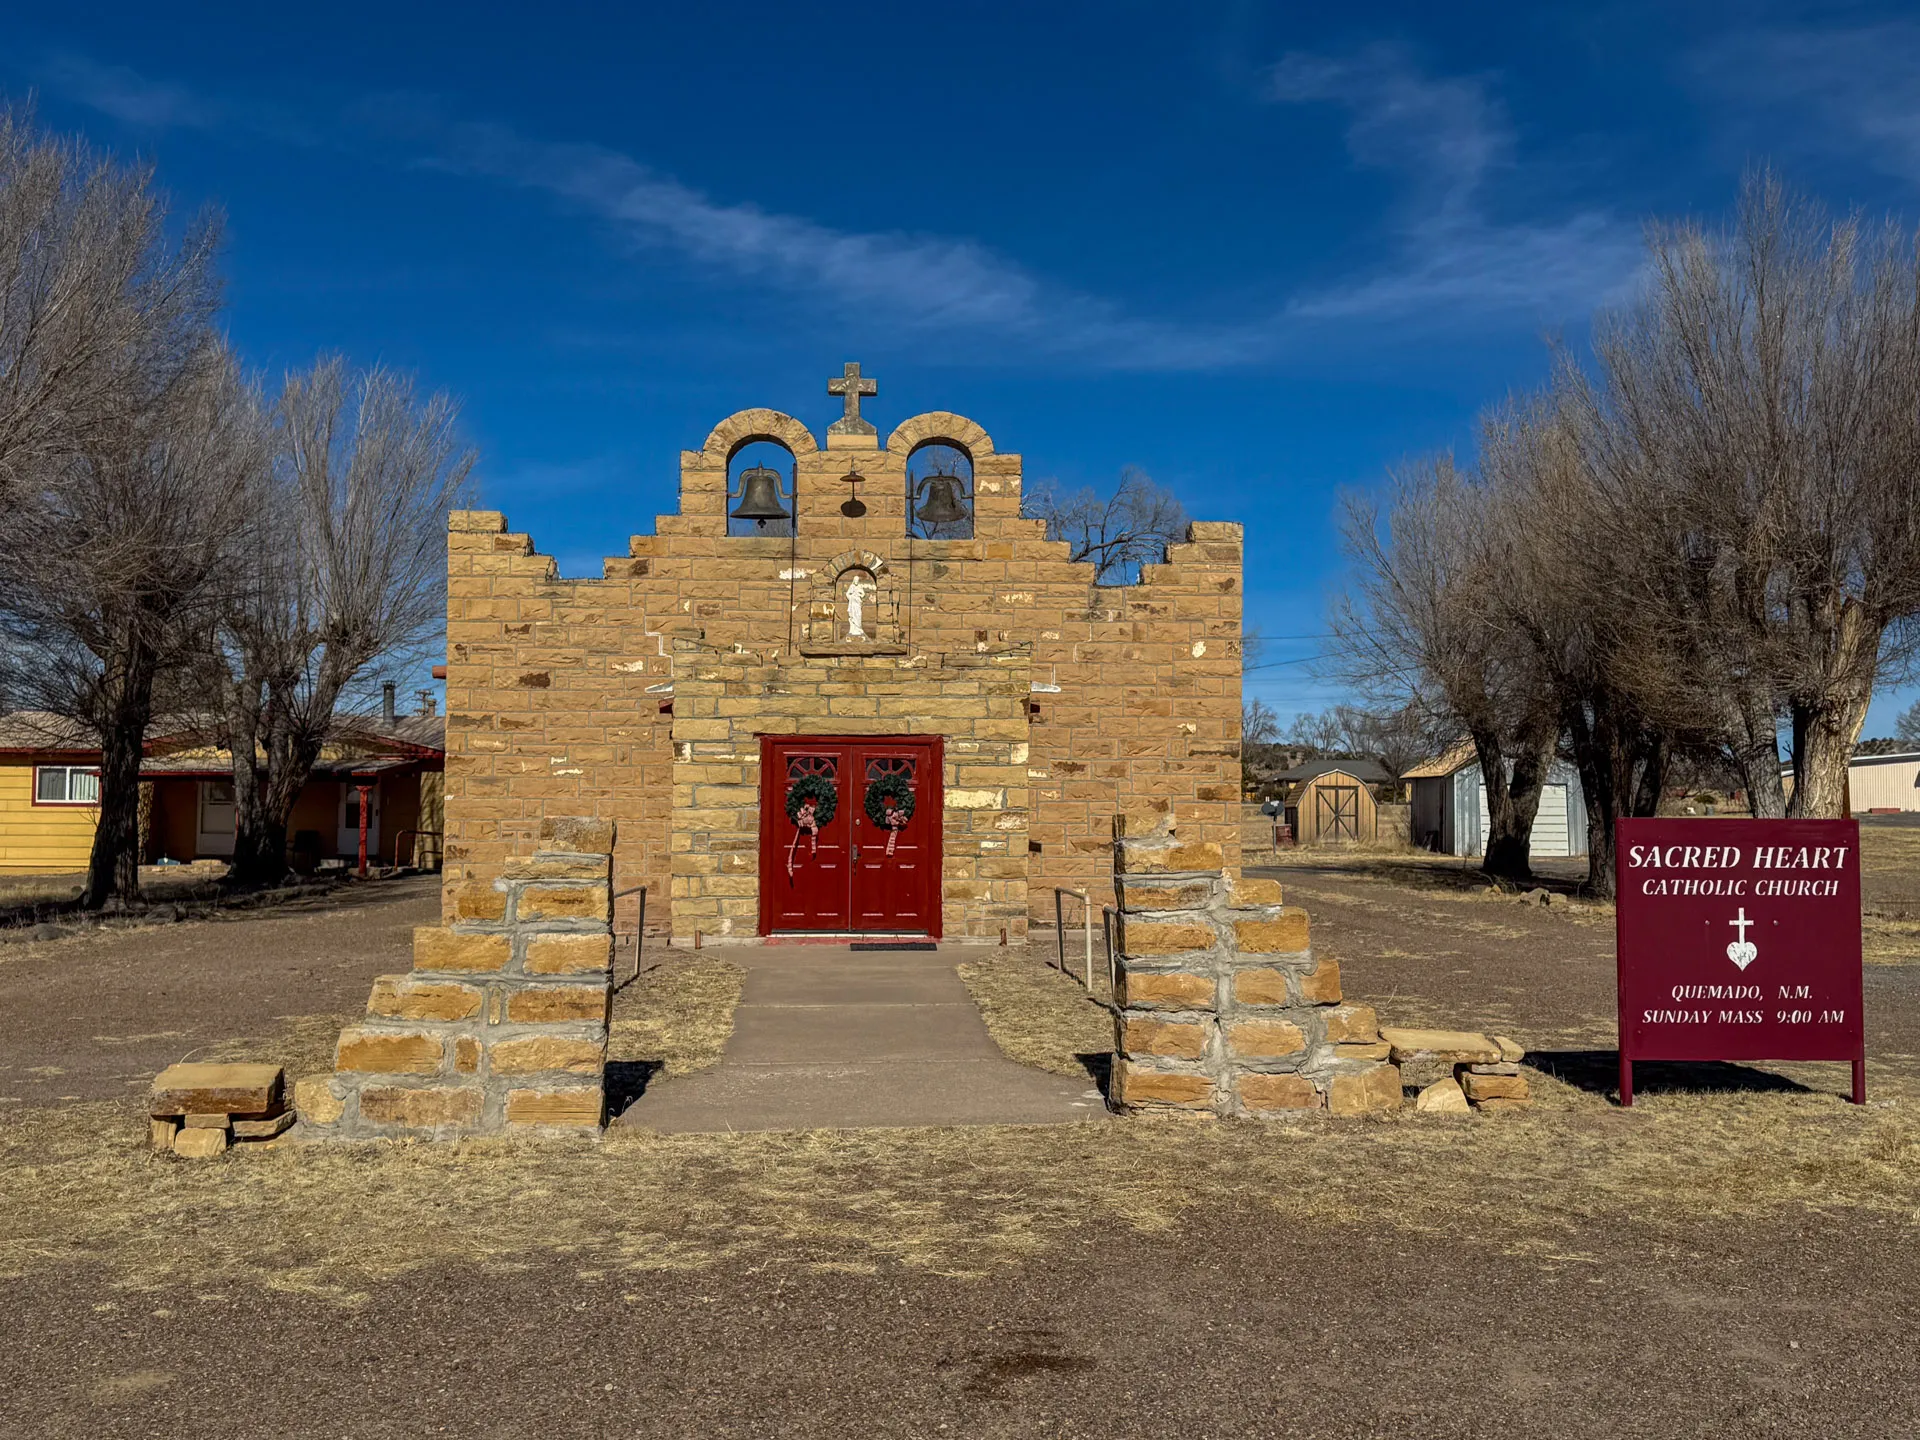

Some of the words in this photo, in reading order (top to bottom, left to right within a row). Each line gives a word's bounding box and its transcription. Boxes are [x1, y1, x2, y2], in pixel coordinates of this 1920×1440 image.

[1628, 845, 1741, 869] SACRED
[1752, 845, 1849, 869] HEART
[1642, 878, 1747, 896] CATHOLIC
[1754, 879, 1839, 896] CHURCH
[1671, 985, 1764, 1003] QUEMADO,
[1778, 985, 1813, 999] N.M.
[1642, 1009, 1712, 1024] SUNDAY
[1718, 1009, 1764, 1024] MASS
[1776, 1009, 1812, 1024] 9:00
[1818, 1009, 1845, 1024] AM
